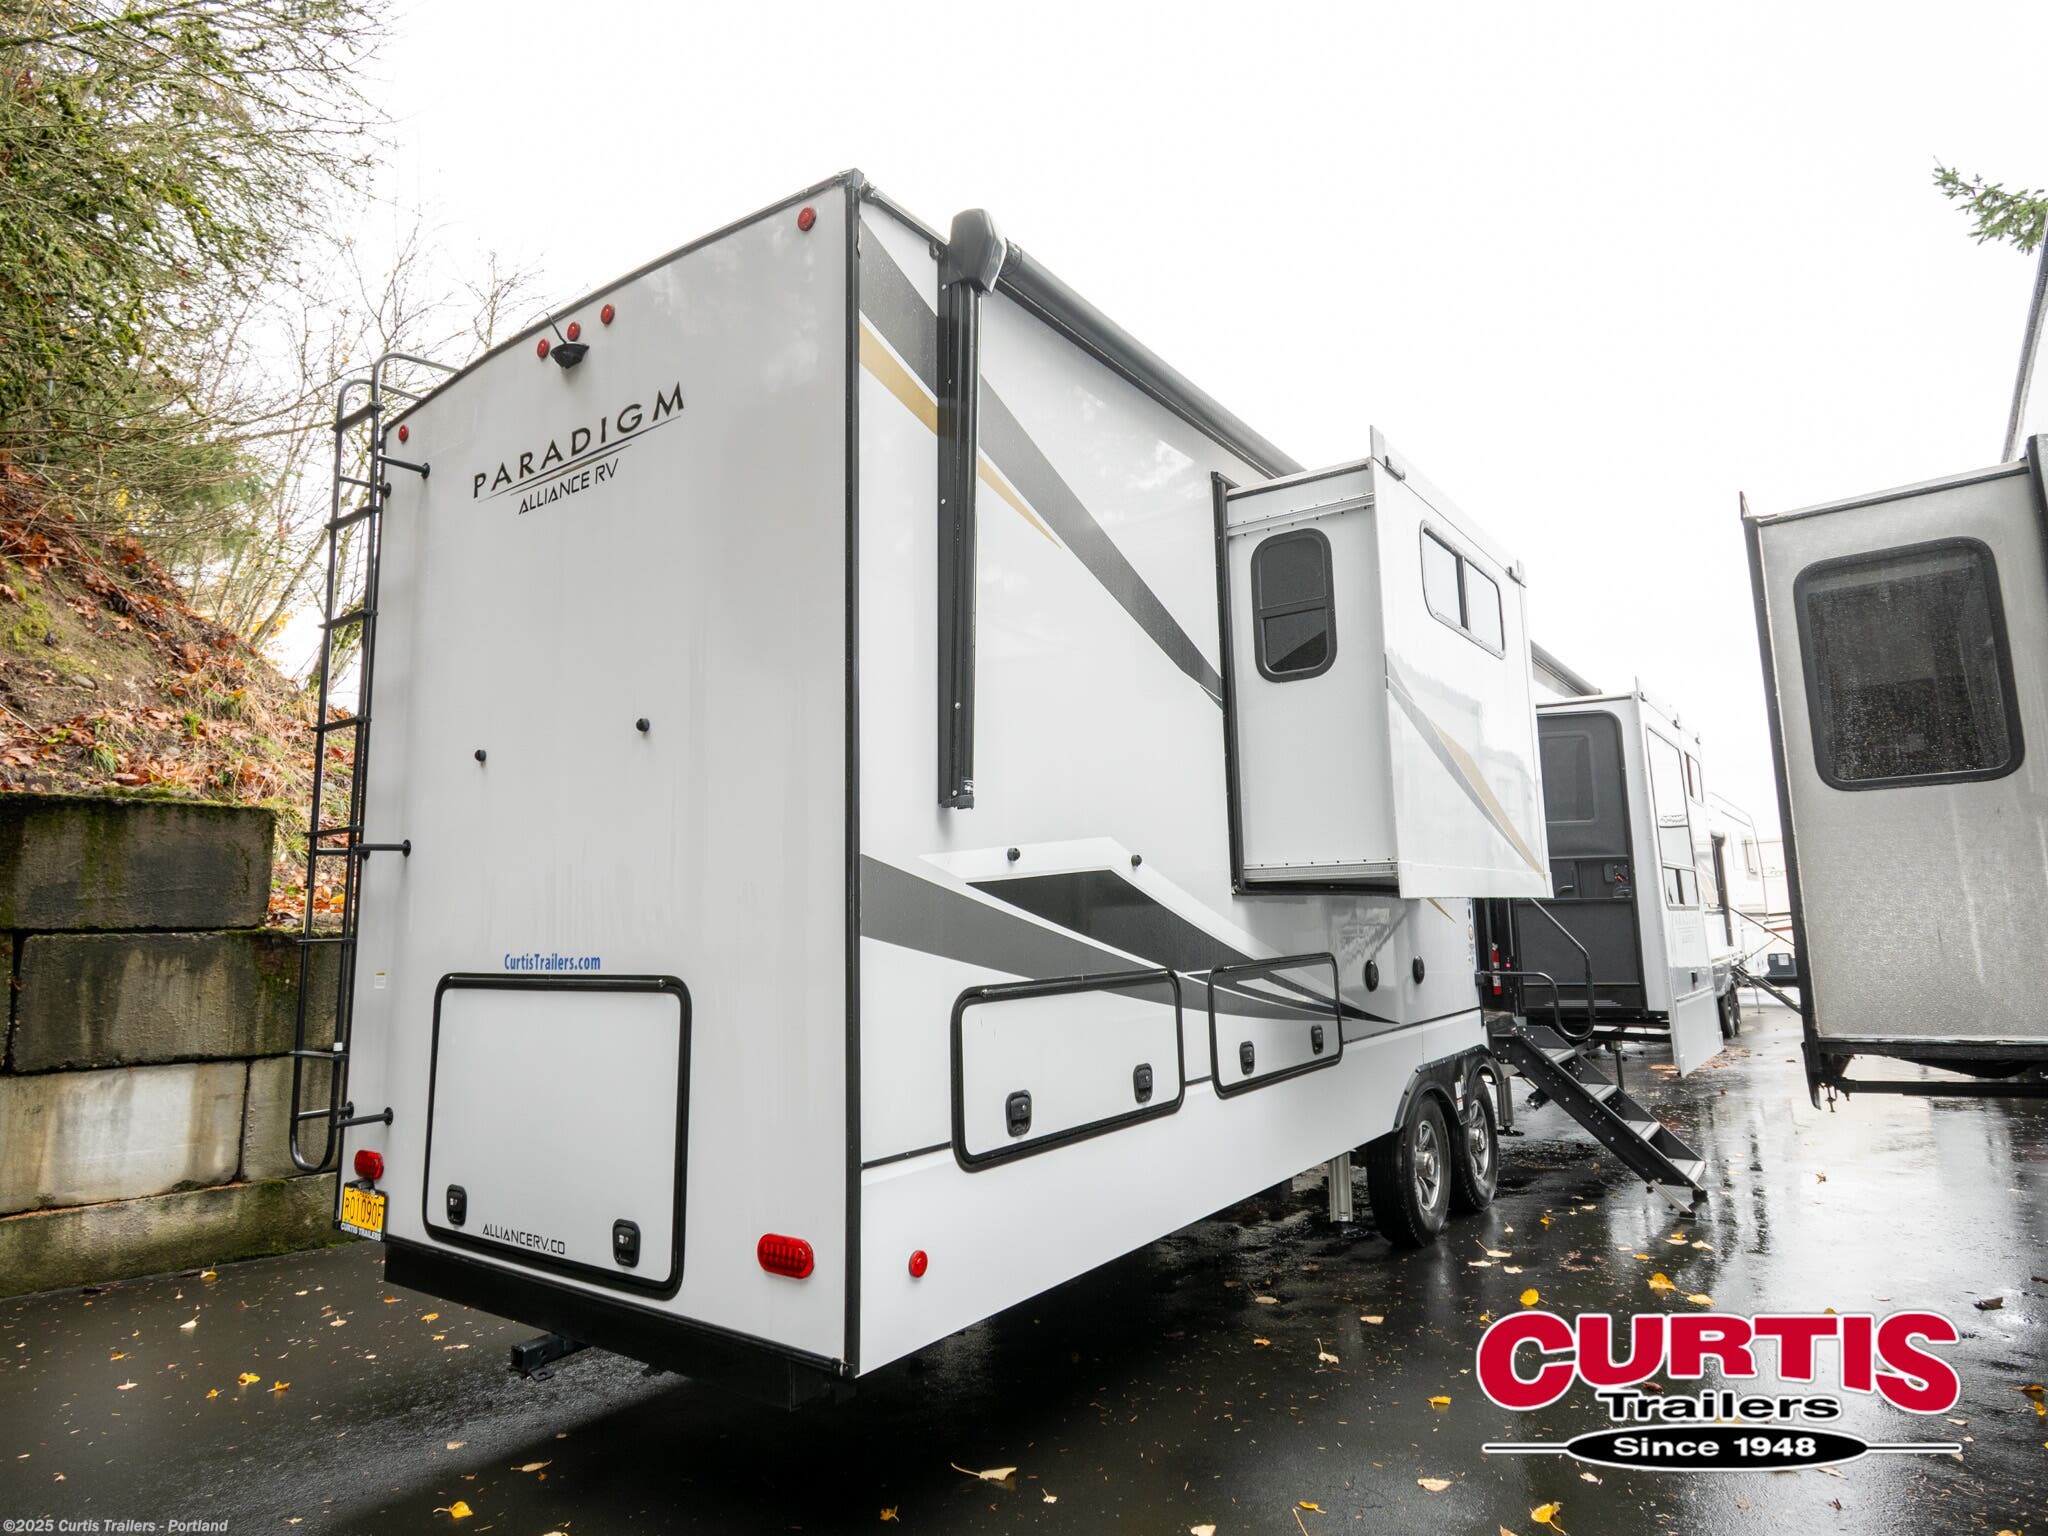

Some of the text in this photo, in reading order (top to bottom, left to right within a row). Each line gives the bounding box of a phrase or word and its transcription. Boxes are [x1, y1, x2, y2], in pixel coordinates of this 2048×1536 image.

[473, 381, 685, 499] PARADIGM
[518, 457, 619, 515] ALLIANCE RV
[504, 953, 601, 970] CurtisTrailers.com
[482, 1223, 566, 1255] ALLIANCERV.CO
